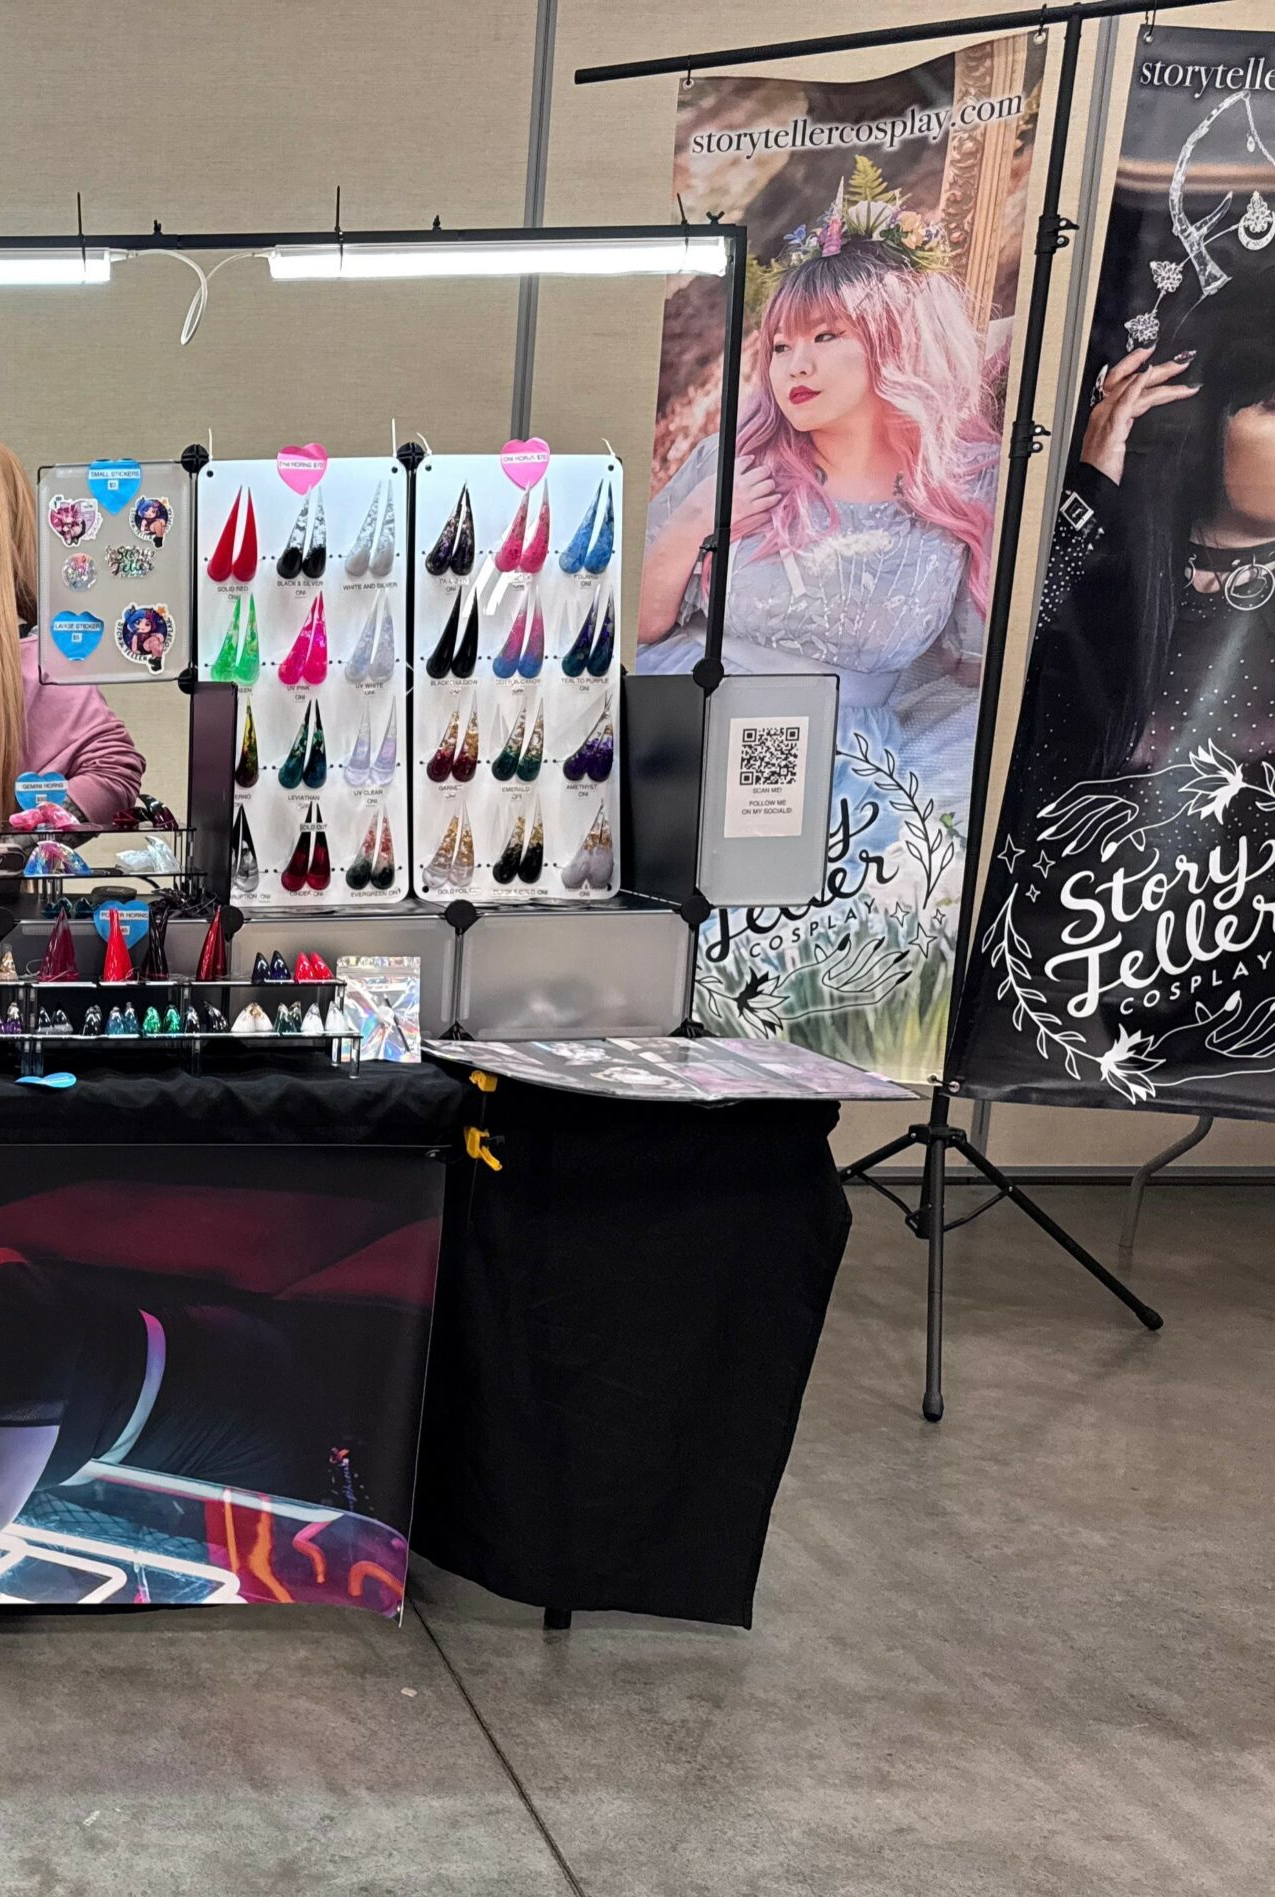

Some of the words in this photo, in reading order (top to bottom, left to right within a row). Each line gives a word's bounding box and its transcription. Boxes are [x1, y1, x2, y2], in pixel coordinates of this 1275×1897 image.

[692, 92, 1023, 159] storytellercosplay.com
[1060, 835, 1275, 945] Story
[750, 898, 875, 958] COSPLAY
[1120, 951, 1271, 1015] COSPLAY
